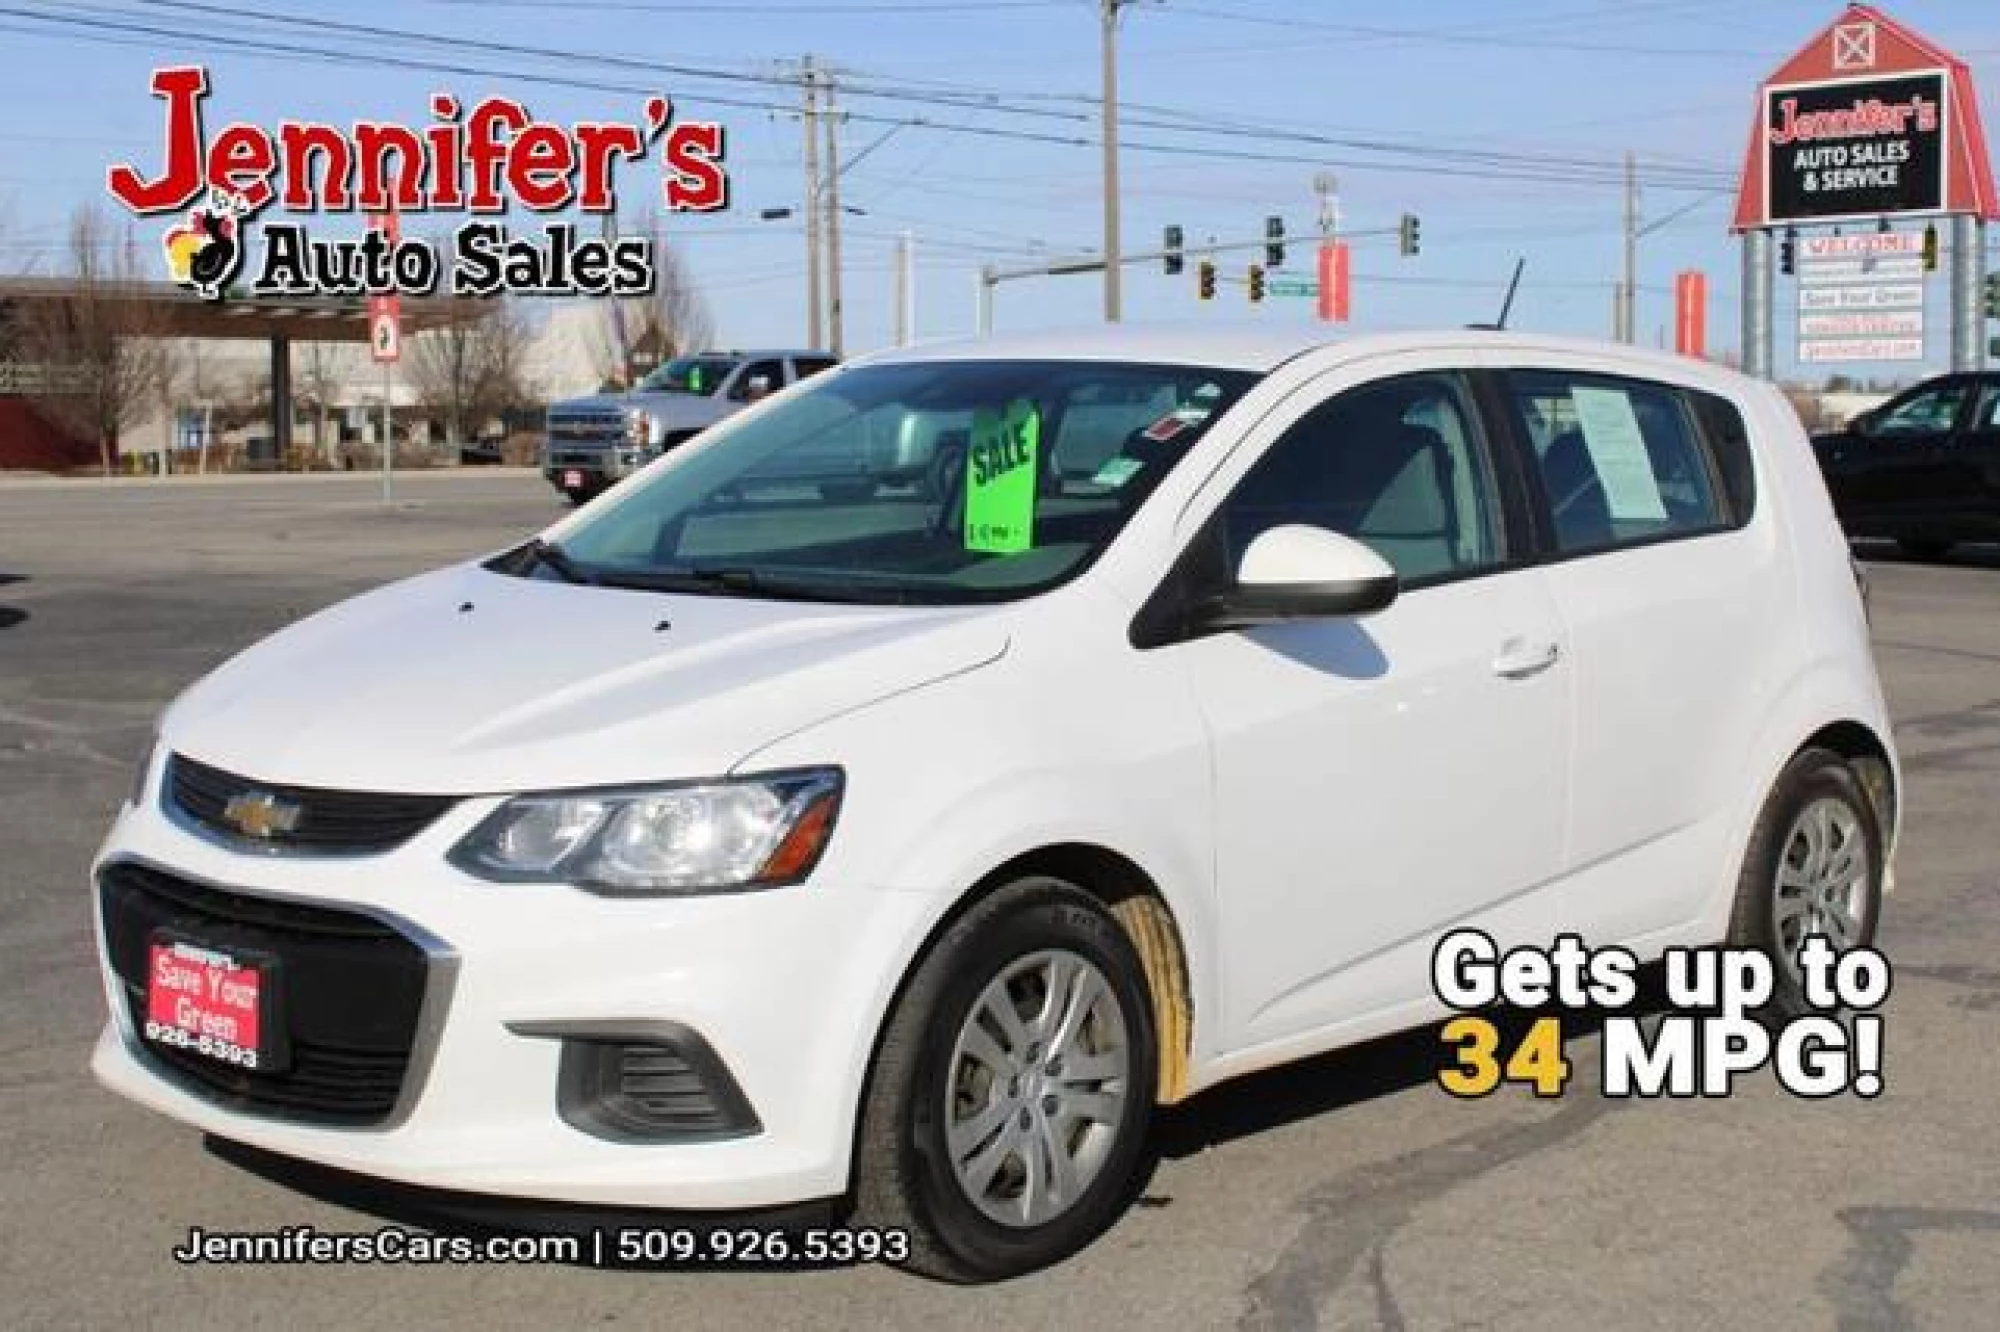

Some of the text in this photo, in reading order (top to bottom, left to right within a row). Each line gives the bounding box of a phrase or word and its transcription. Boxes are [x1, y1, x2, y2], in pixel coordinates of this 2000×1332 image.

[1769, 94, 1937, 145] Jennifer's
[1794, 140, 1911, 171] AUTO SALES
[1803, 165, 1898, 191] & SERVICE
[972, 422, 1029, 487] SALE
[158, 954, 201, 996] Save
[208, 966, 257, 1010] Your
[177, 995, 238, 1042] Green
